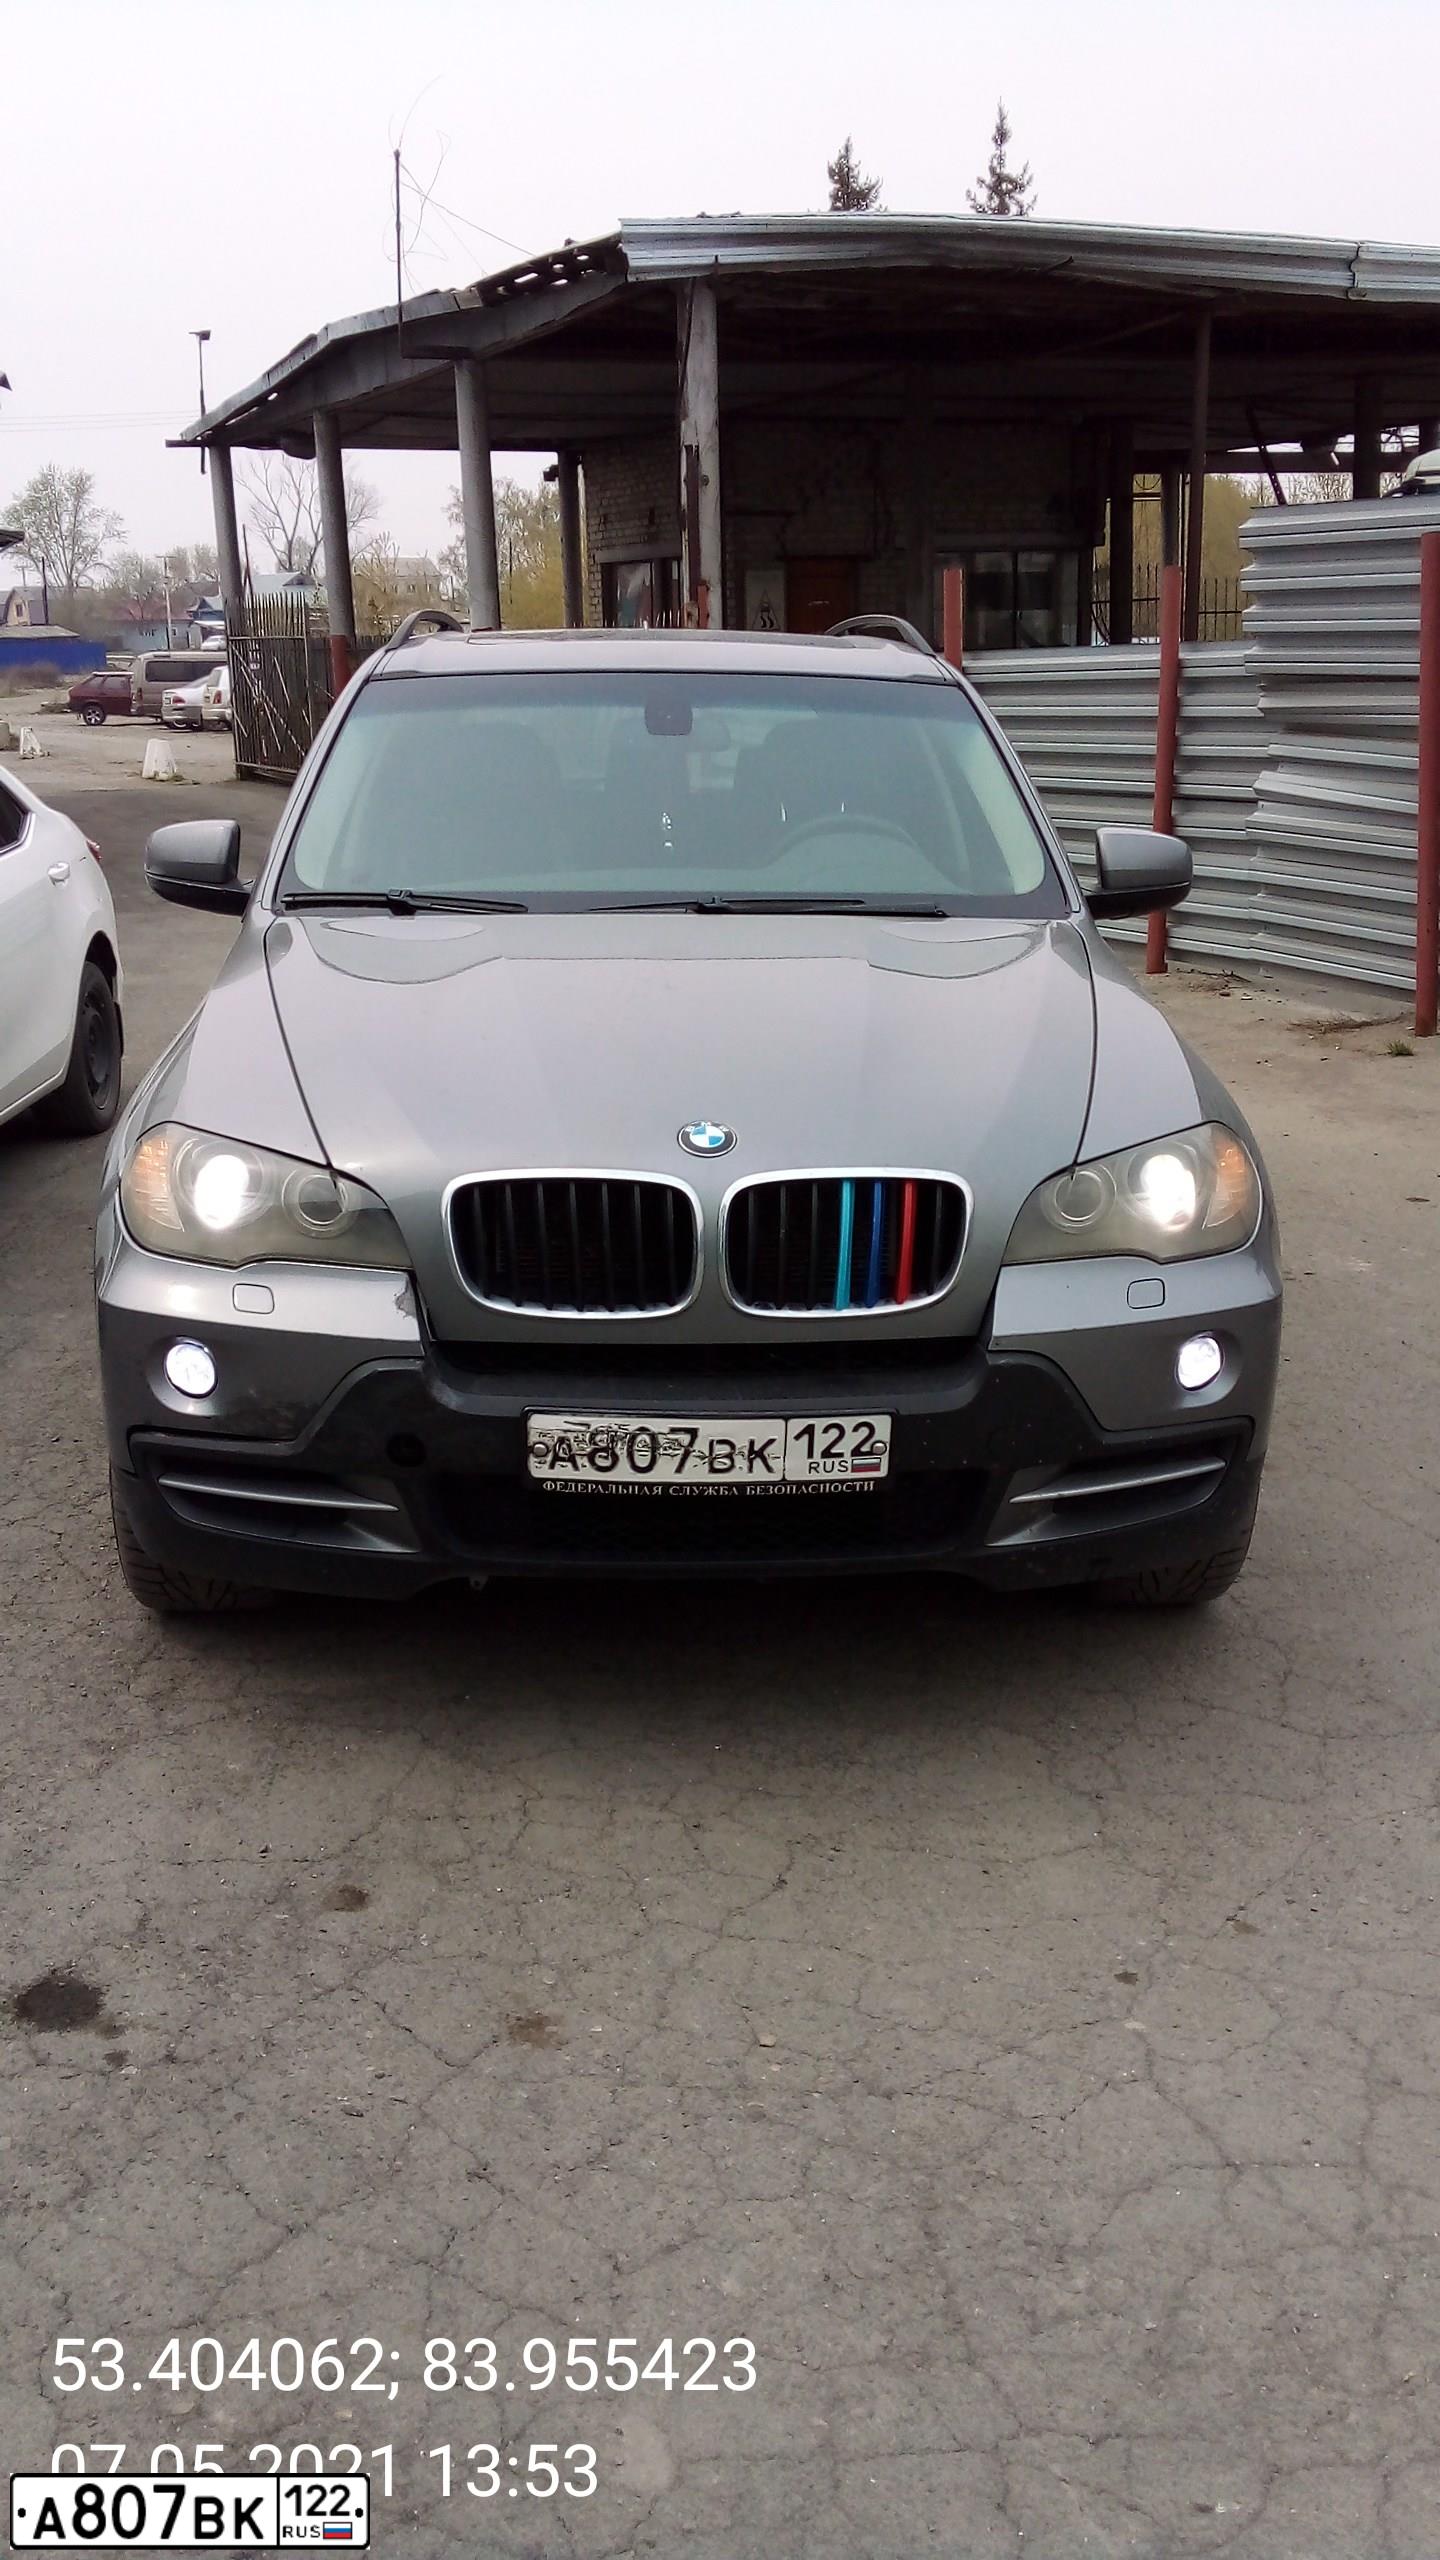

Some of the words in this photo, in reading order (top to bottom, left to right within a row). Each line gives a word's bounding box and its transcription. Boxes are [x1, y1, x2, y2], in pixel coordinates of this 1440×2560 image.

[793, 1421, 877, 1459] 122
[808, 1460, 849, 1474] RUS
[542, 1480, 663, 1496] ФЕДЕРАЛЬНАЯ
[669, 1485, 739, 1496] СЛУЖБА
[746, 1480, 876, 1496] БЕЗОПАСНОСТИ
